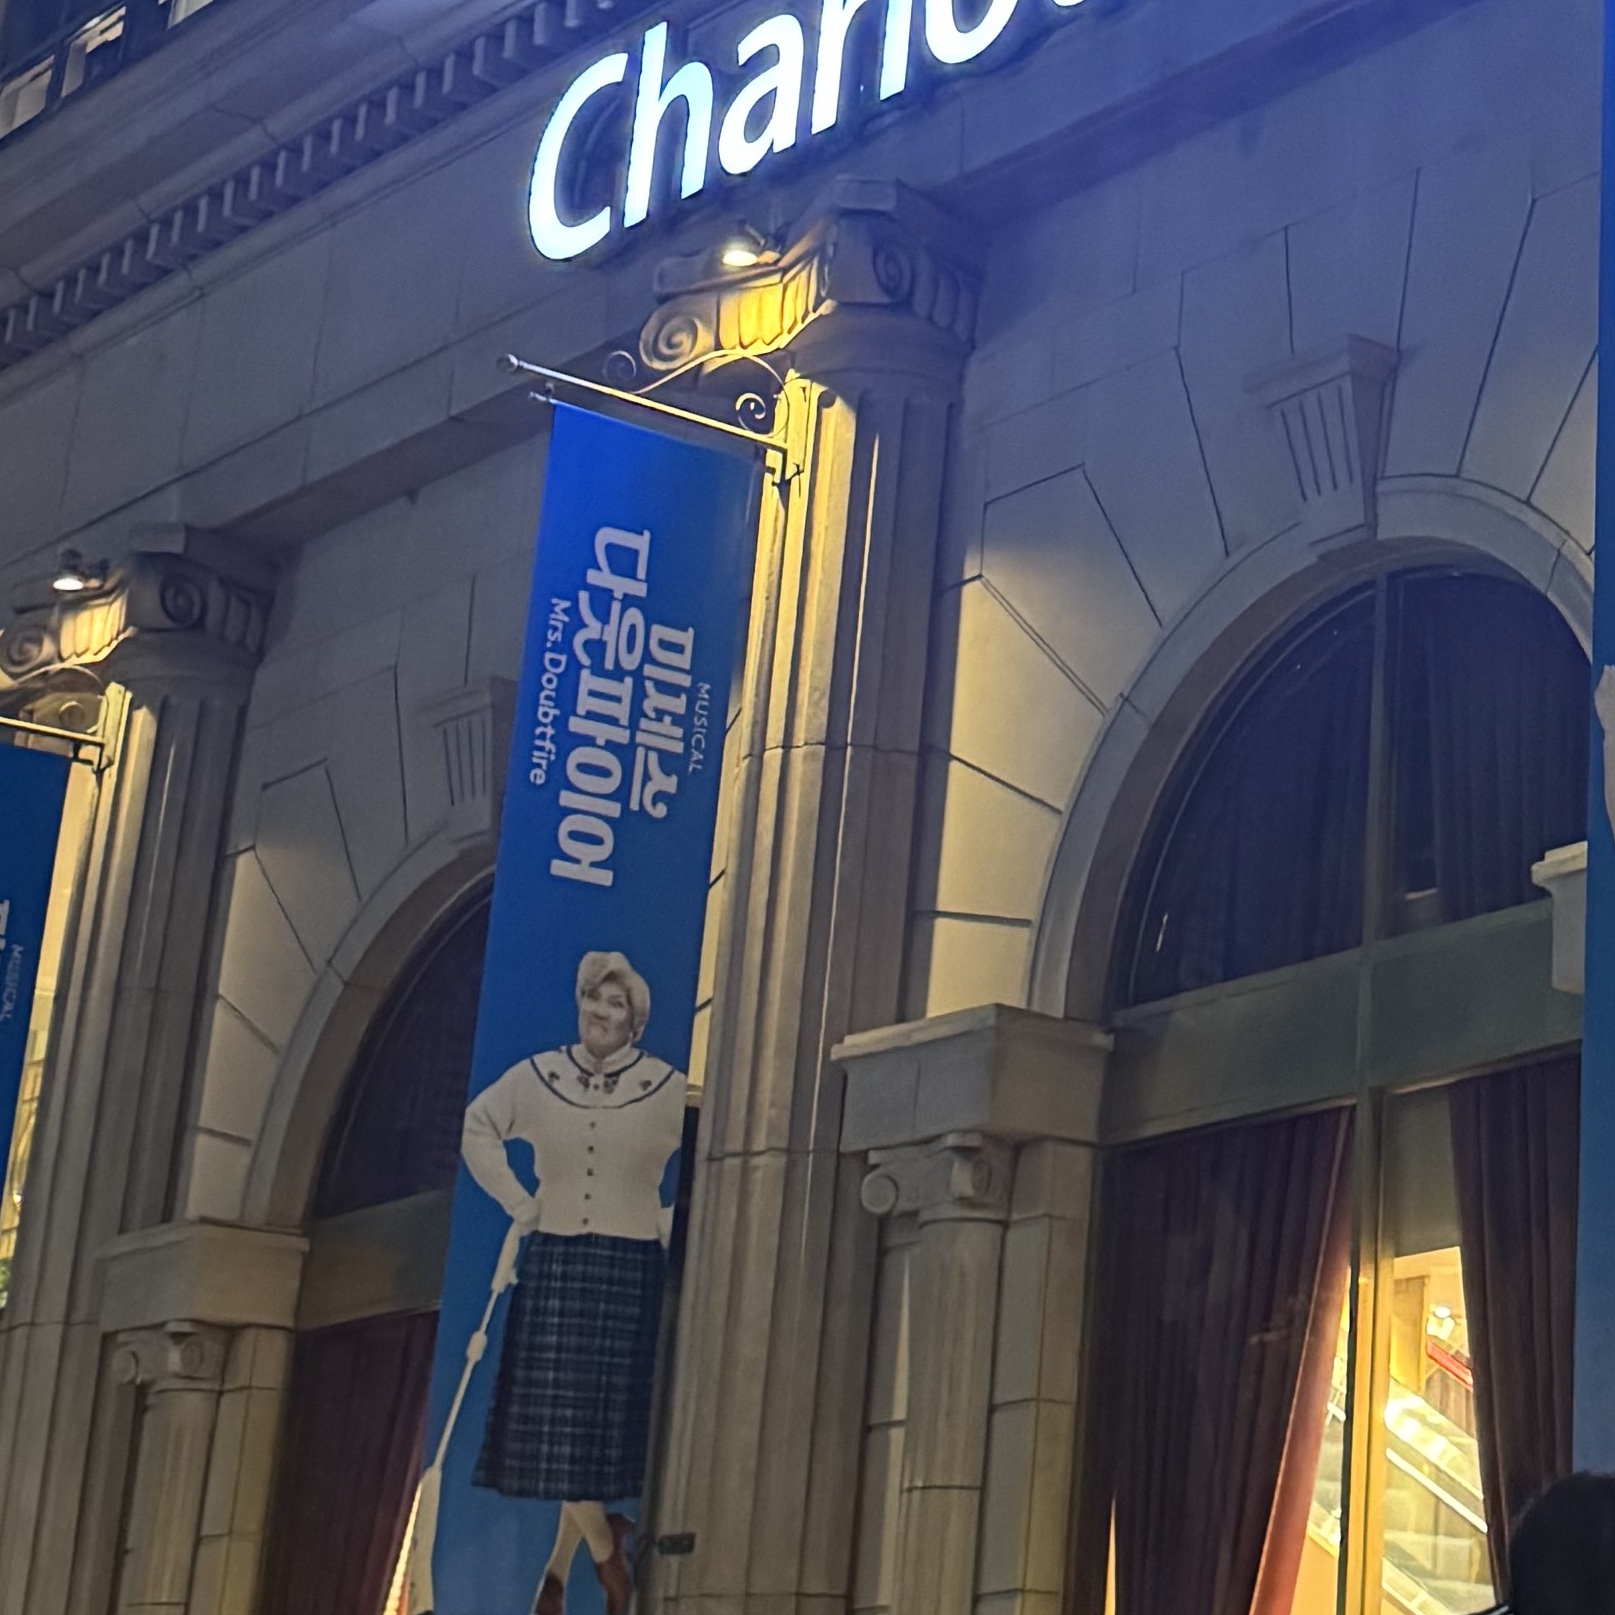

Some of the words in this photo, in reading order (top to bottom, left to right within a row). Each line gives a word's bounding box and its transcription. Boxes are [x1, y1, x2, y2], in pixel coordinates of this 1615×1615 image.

[528, 0, 1088, 261] Char
[546, 597, 571, 648] Mrs.
[529, 652, 568, 787] Doubtfire
[550, 526, 651, 887] 다웃파이어
[630, 624, 694, 819] 미세스
[688, 682, 711, 774] MUSICAL
